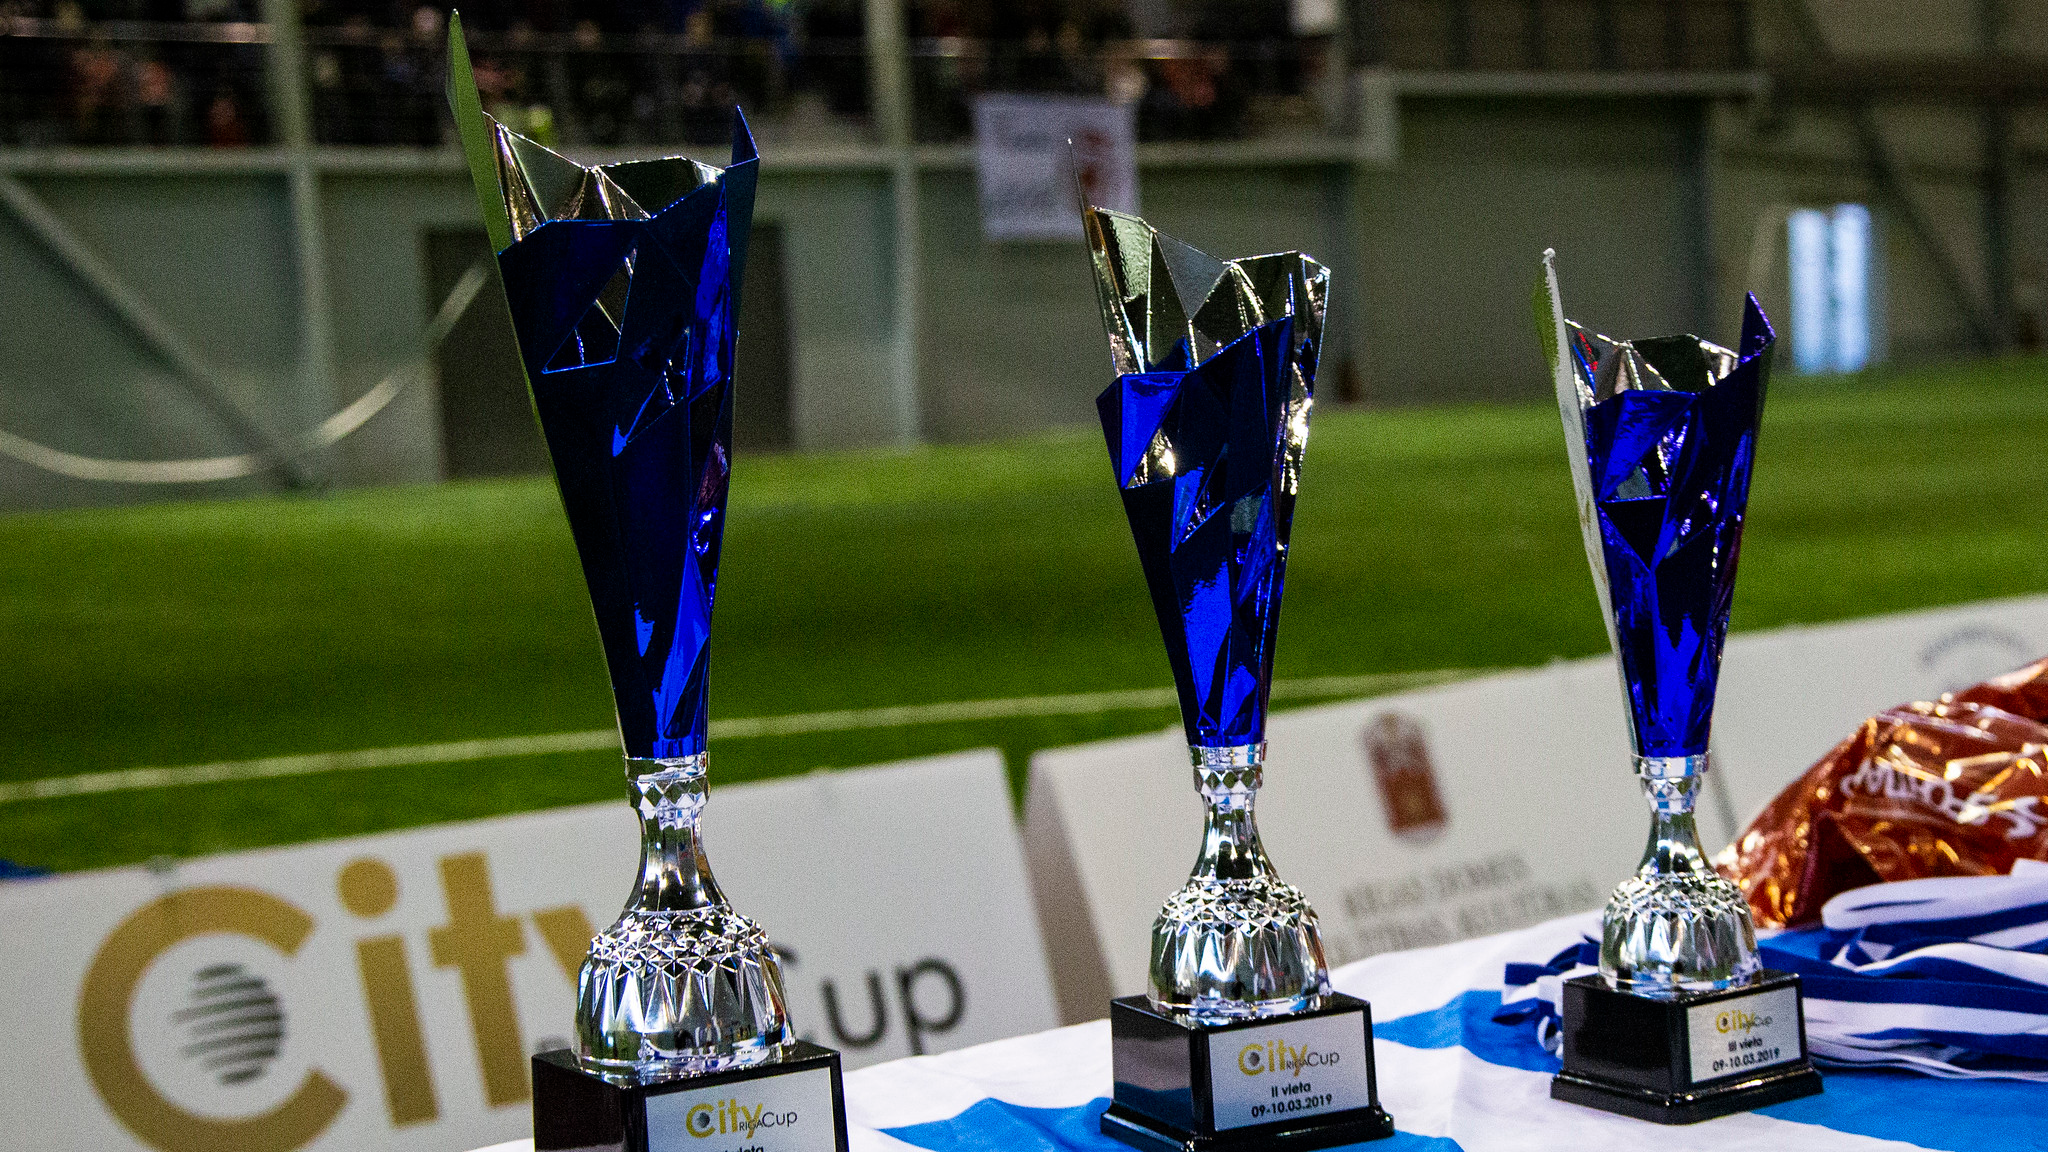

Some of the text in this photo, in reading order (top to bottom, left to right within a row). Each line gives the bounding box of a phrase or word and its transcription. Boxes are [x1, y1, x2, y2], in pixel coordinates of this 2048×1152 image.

[1716, 1009, 1756, 1034] City
[1739, 1036, 1763, 1049] vieta
[1238, 1039, 1308, 1078] City
[1307, 1051, 1340, 1067] Cup
[1712, 1048, 1780, 1072] 09-10.03.2019
[1271, 1081, 1312, 1098] II vieta
[1251, 1093, 1332, 1118] 09-10.03.2019
[685, 1098, 763, 1139] City
[762, 1111, 798, 1127] Cup
